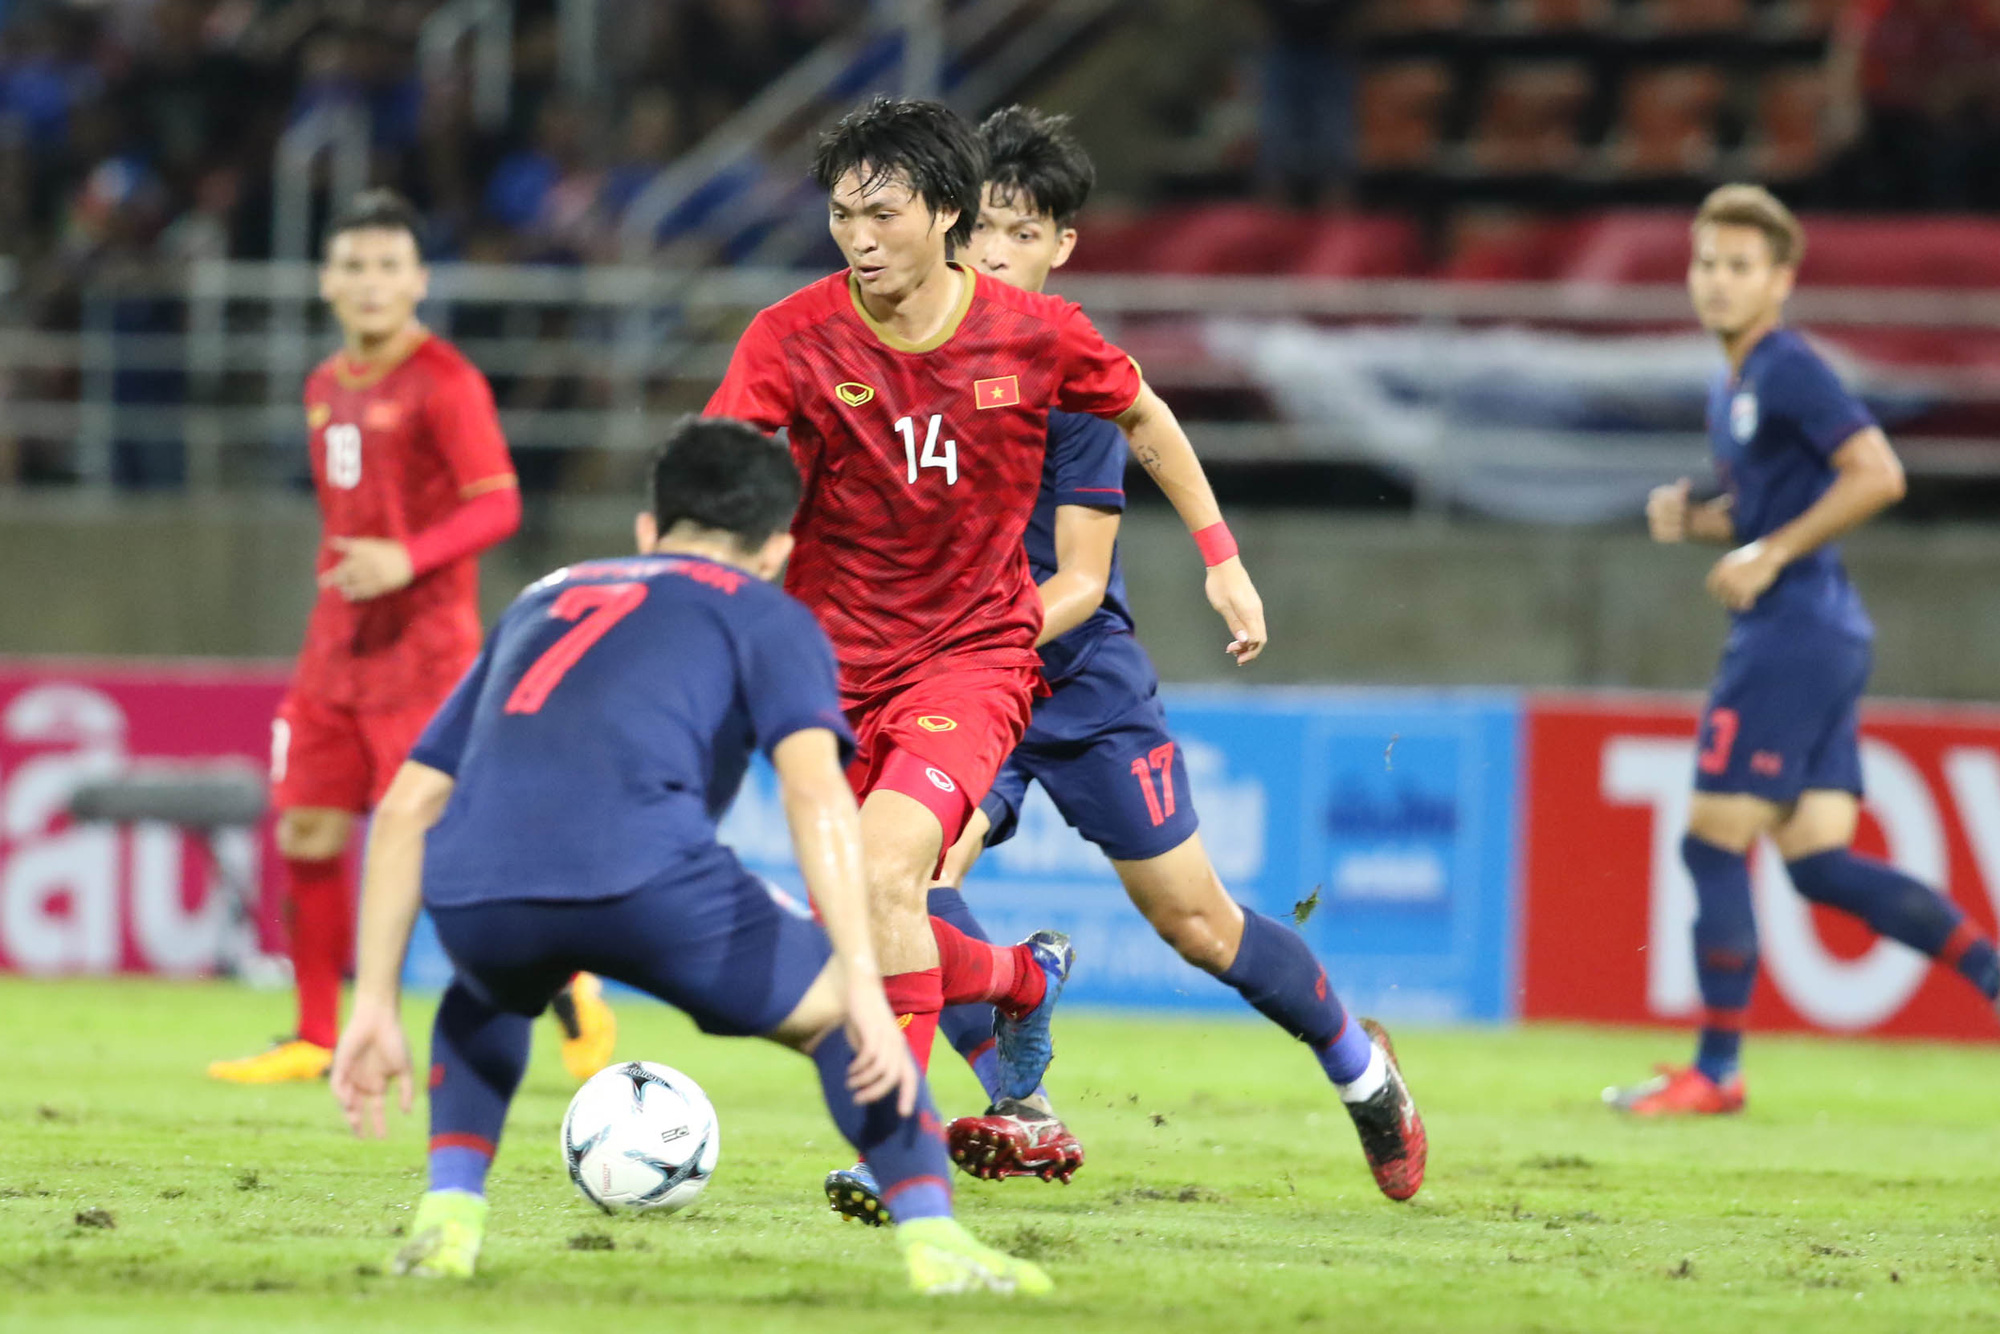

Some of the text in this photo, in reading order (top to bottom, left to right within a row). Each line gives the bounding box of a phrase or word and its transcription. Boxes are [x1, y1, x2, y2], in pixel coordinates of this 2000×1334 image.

[894, 414, 958, 486] 14
[504, 582, 648, 715] 7
[1131, 742, 1175, 826] 17
